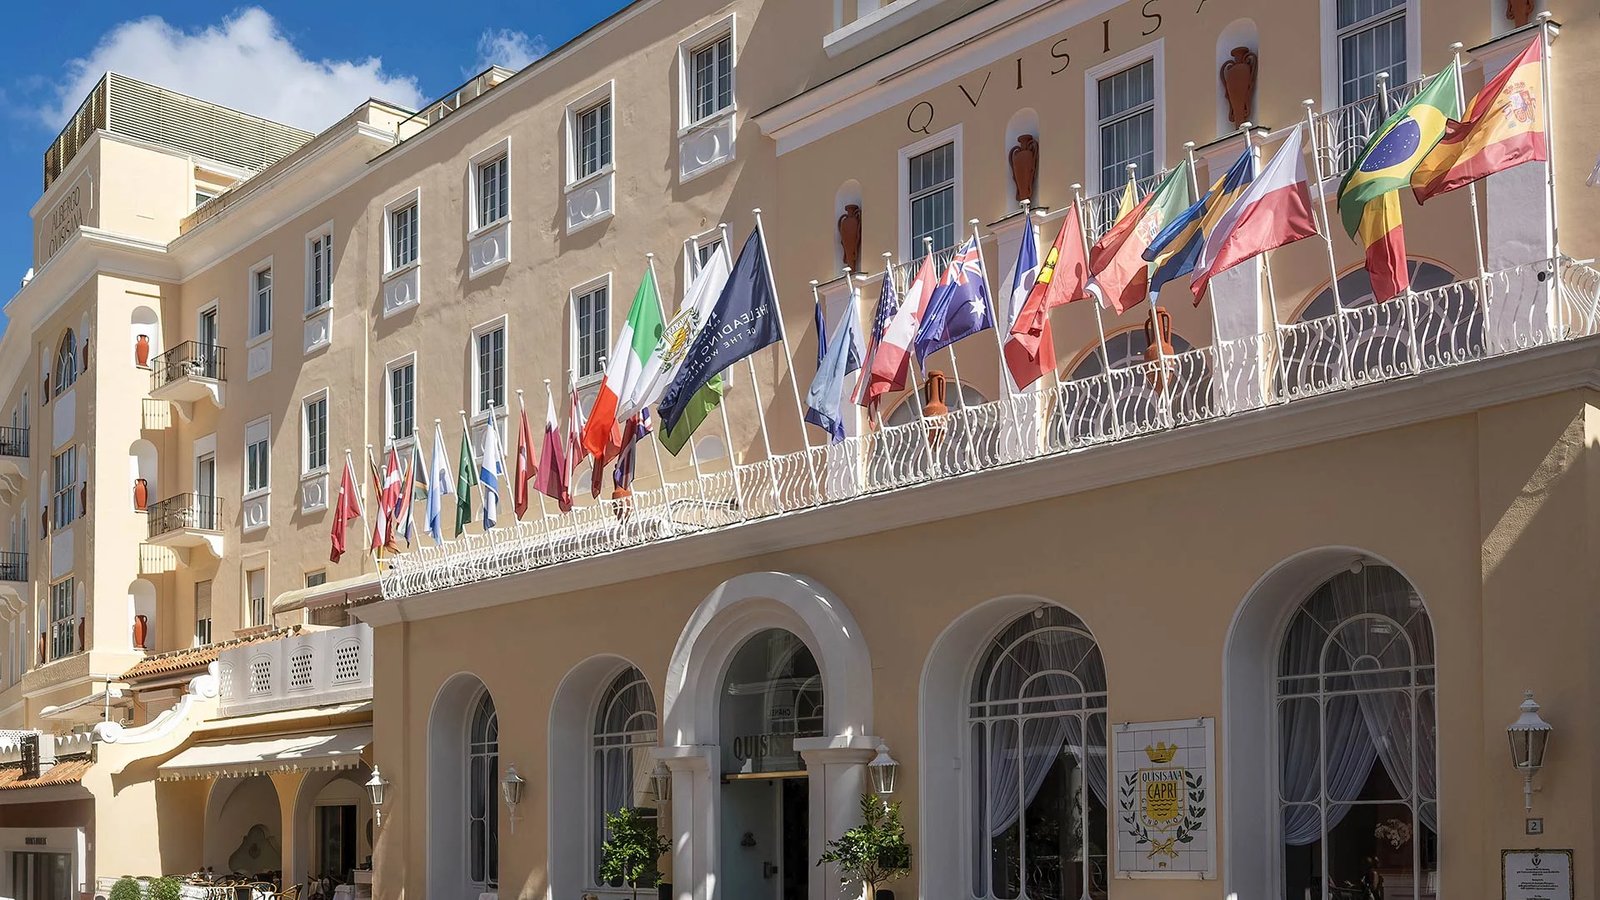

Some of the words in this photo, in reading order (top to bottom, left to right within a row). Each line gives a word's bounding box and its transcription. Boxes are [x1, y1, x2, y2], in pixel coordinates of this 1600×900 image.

[906, 0, 1207, 135] QVISIS
[1142, 771, 1183, 782] QUISISANA
[1148, 783, 1177, 799] CAPRI
[1531, 821, 1537, 830] 2
